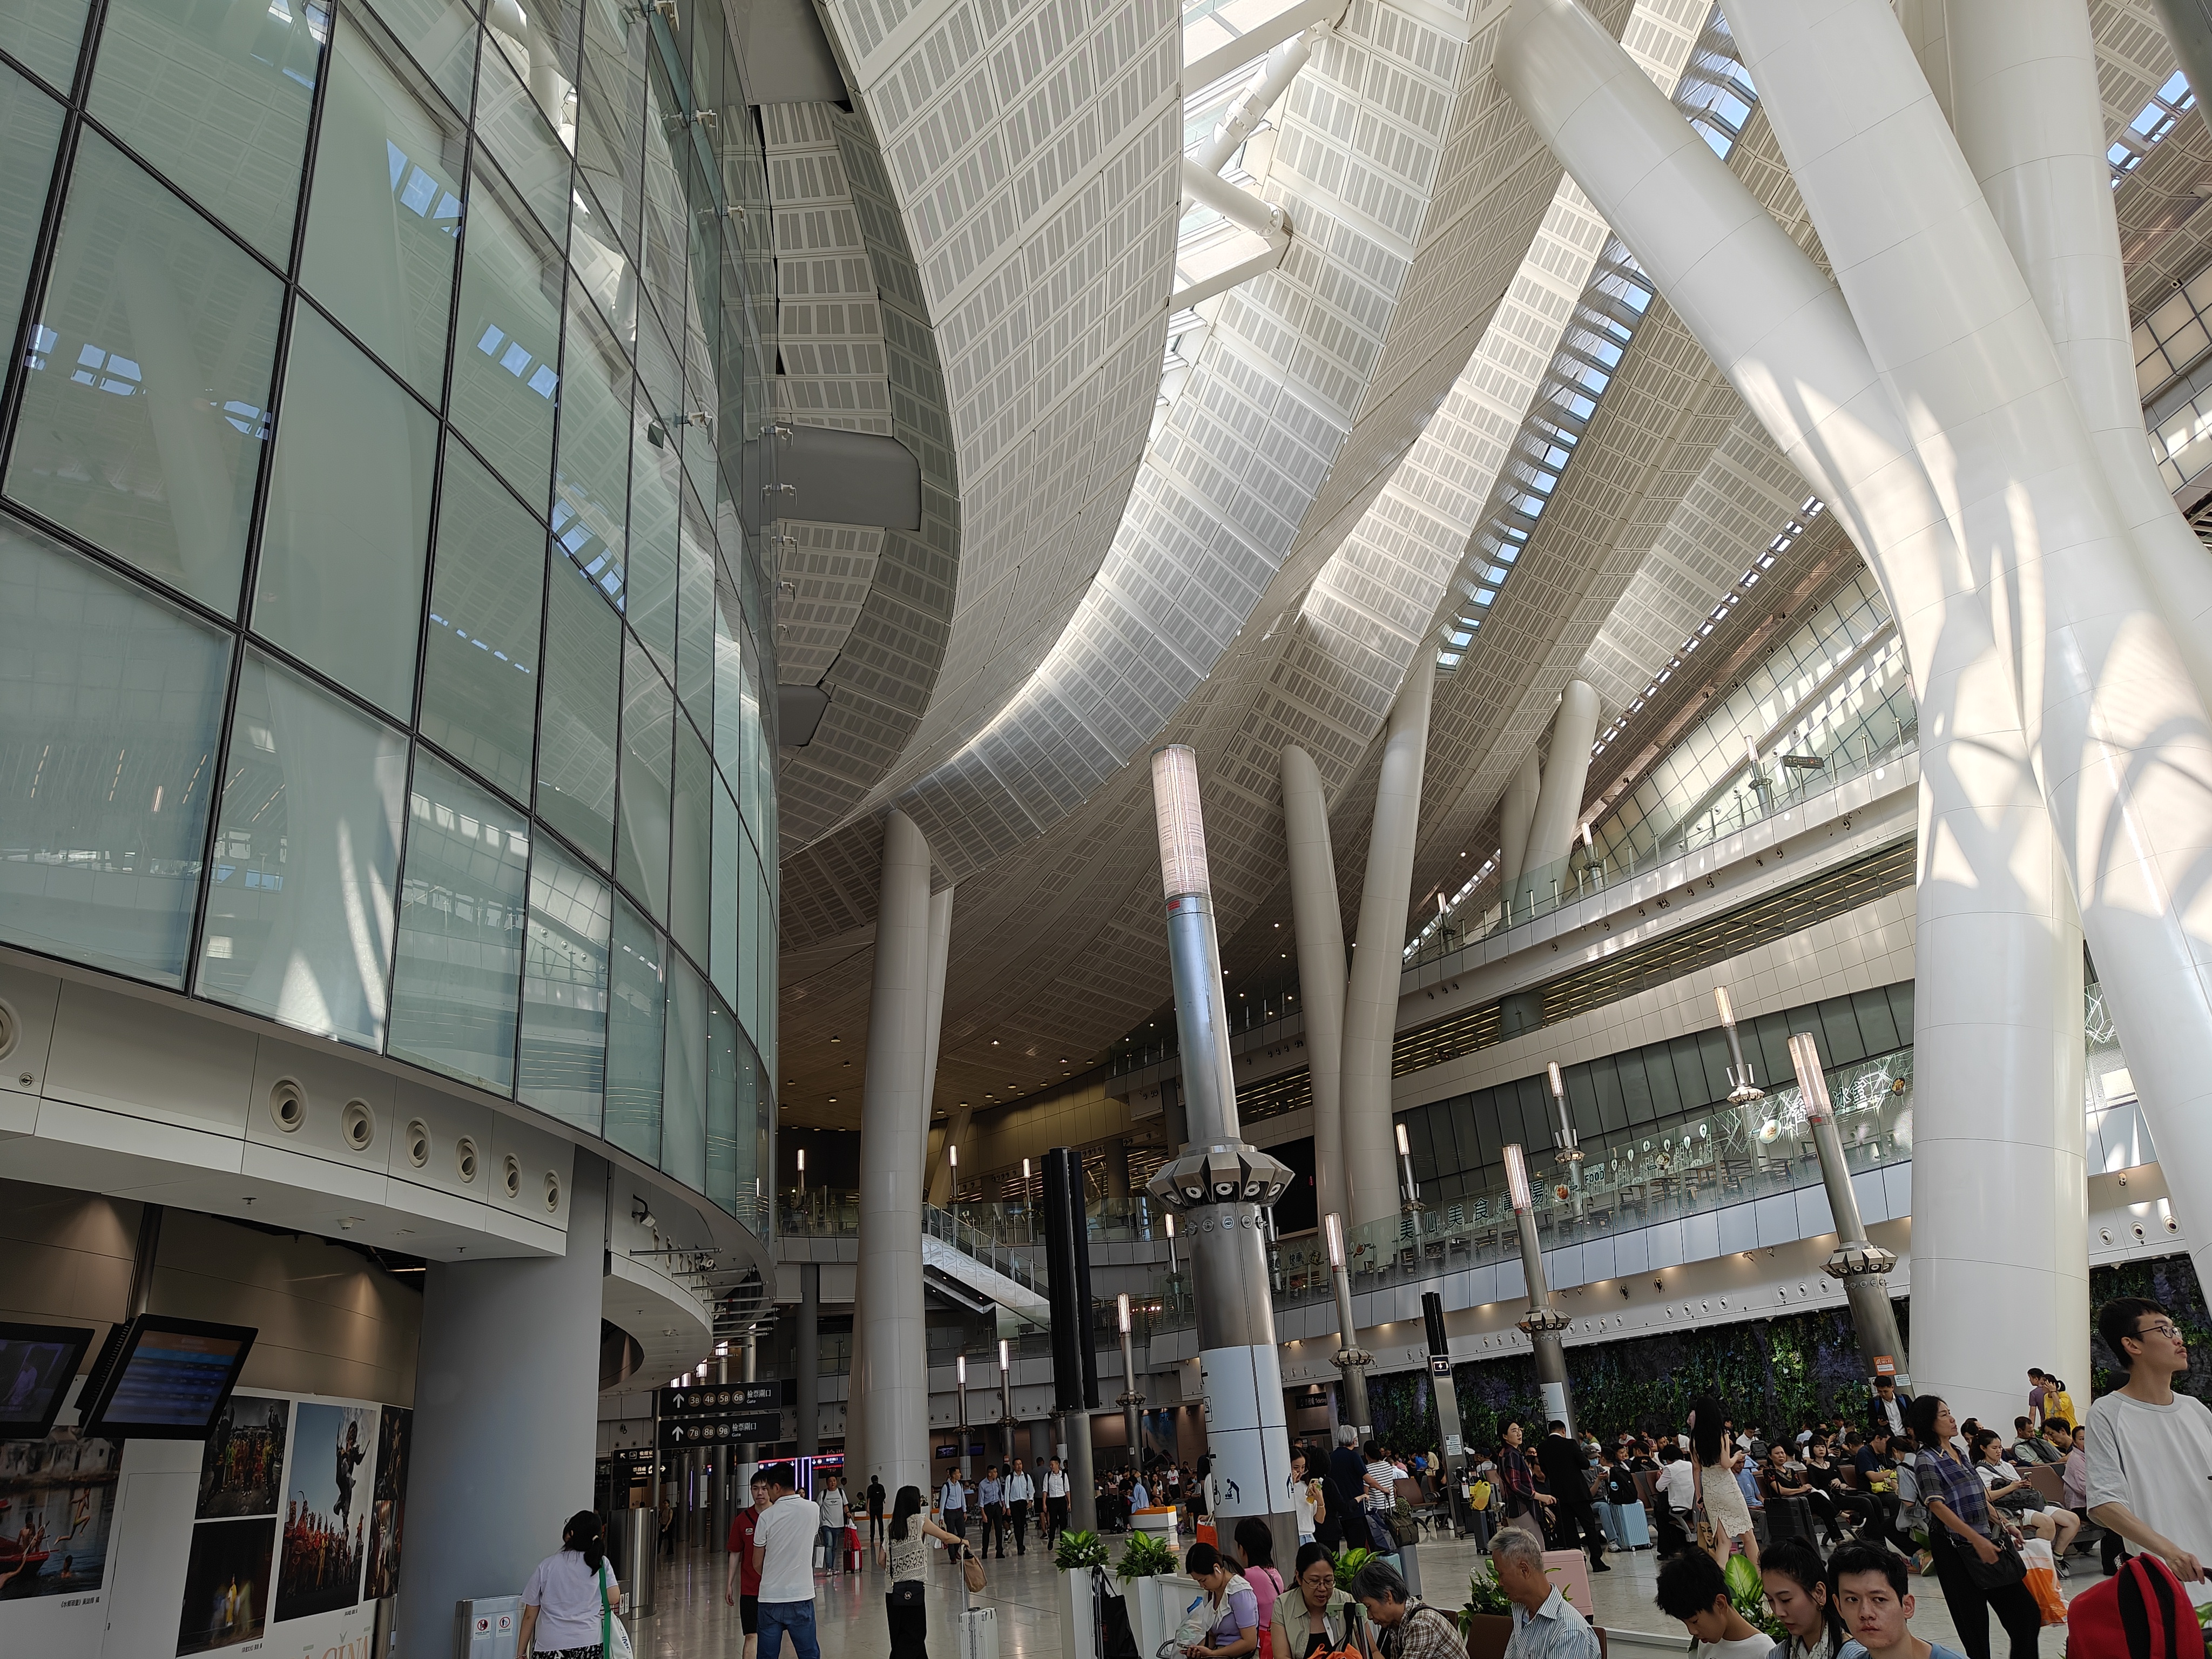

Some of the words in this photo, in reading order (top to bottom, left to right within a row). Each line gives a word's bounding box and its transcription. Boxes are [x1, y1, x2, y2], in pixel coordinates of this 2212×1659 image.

[1584, 1170, 1604, 1185] FOOD
[747, 1389, 771, 1399] 檢票閘口
[732, 1422, 757, 1432] 檢票閘口
